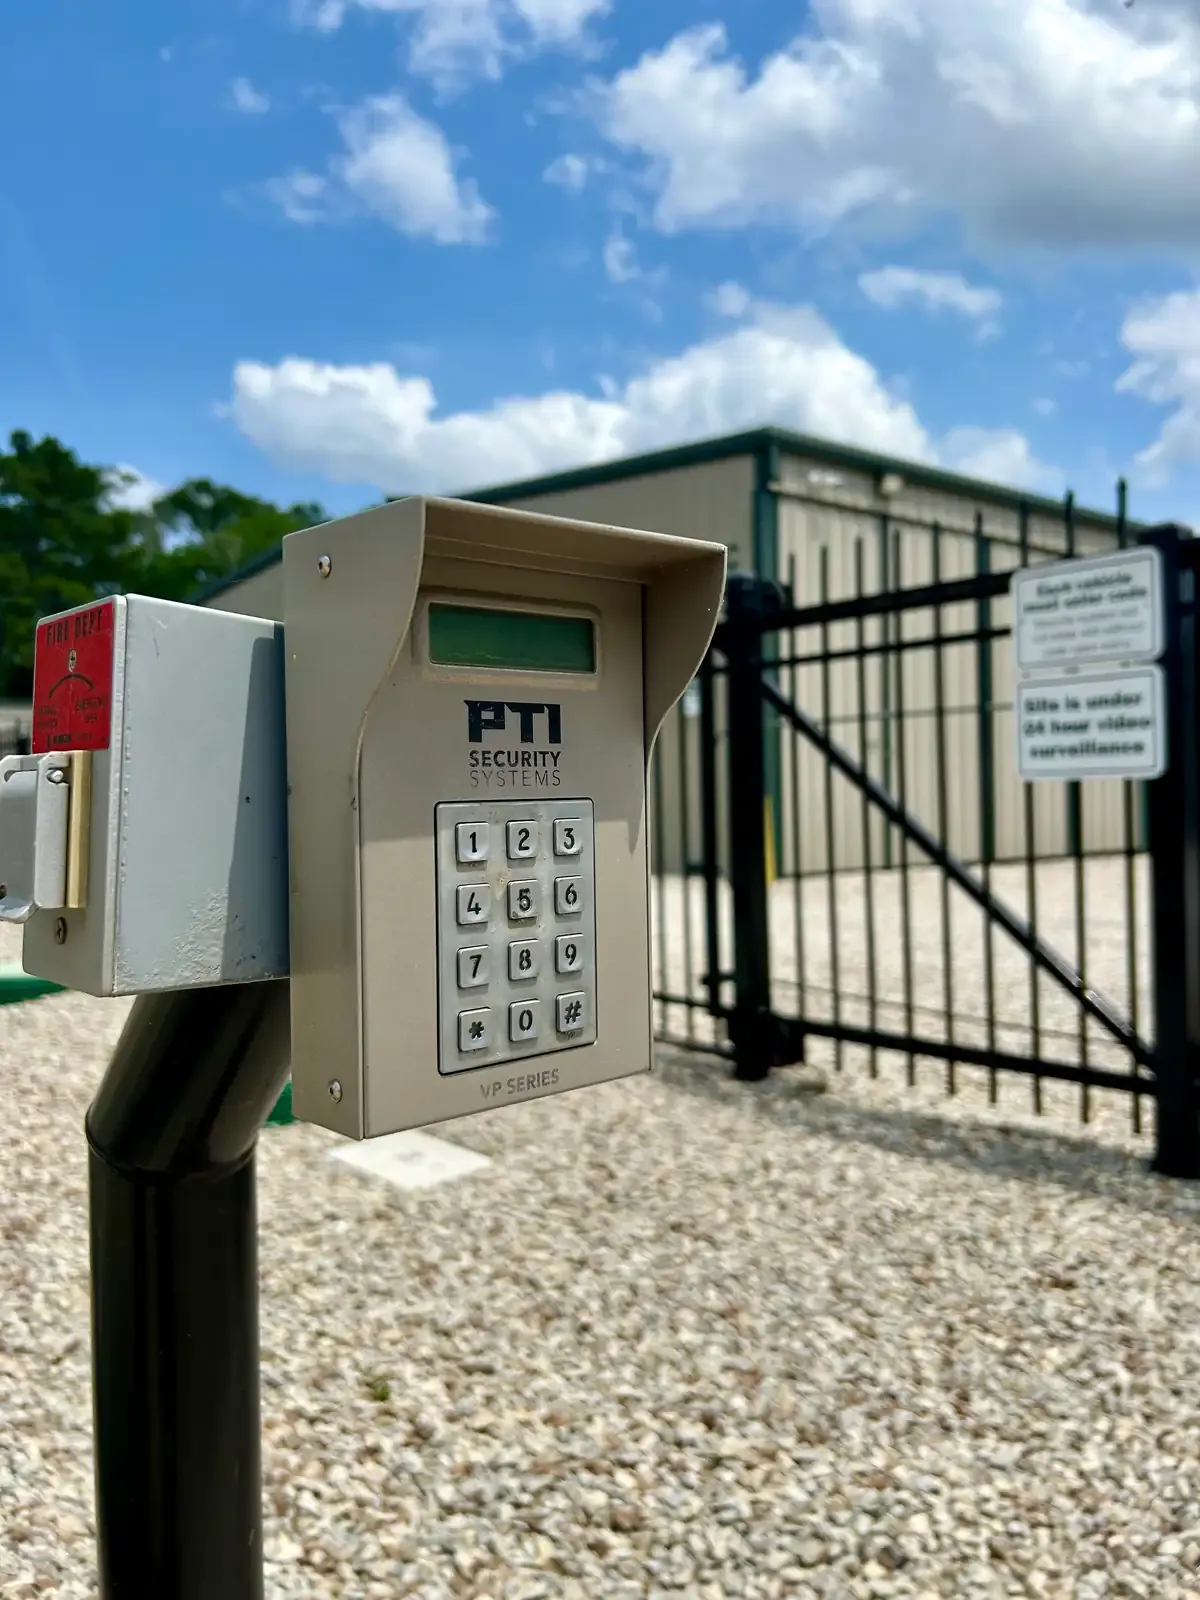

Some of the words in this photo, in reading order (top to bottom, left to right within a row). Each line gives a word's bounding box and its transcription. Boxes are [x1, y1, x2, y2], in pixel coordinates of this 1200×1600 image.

[46, 619, 69, 646] FIRE
[74, 608, 103, 638] DEPT
[1024, 696, 1059, 714] Site
[1065, 693, 1081, 710] is
[1087, 689, 1142, 708] under
[463, 700, 562, 744] PTI
[1024, 719, 1045, 737] 24
[1051, 717, 1090, 734] hour
[1097, 713, 1152, 731] video
[469, 750, 562, 768] SECURITY
[1029, 740, 1144, 759] surveillance
[470, 769, 561, 788] SYSTEMS
[469, 831, 478, 853] 1
[518, 827, 530, 851] 2
[563, 827, 575, 849] 3
[467, 891, 482, 915] 4
[517, 887, 531, 911] 5
[565, 883, 578, 905] 6
[469, 954, 482, 979] 7
[519, 948, 532, 971] 8
[565, 943, 577, 966] 9
[518, 1009, 533, 1032] 0
[564, 1000, 582, 1025] #
[480, 1081, 502, 1099] VP
[507, 1068, 560, 1095] SERIES
